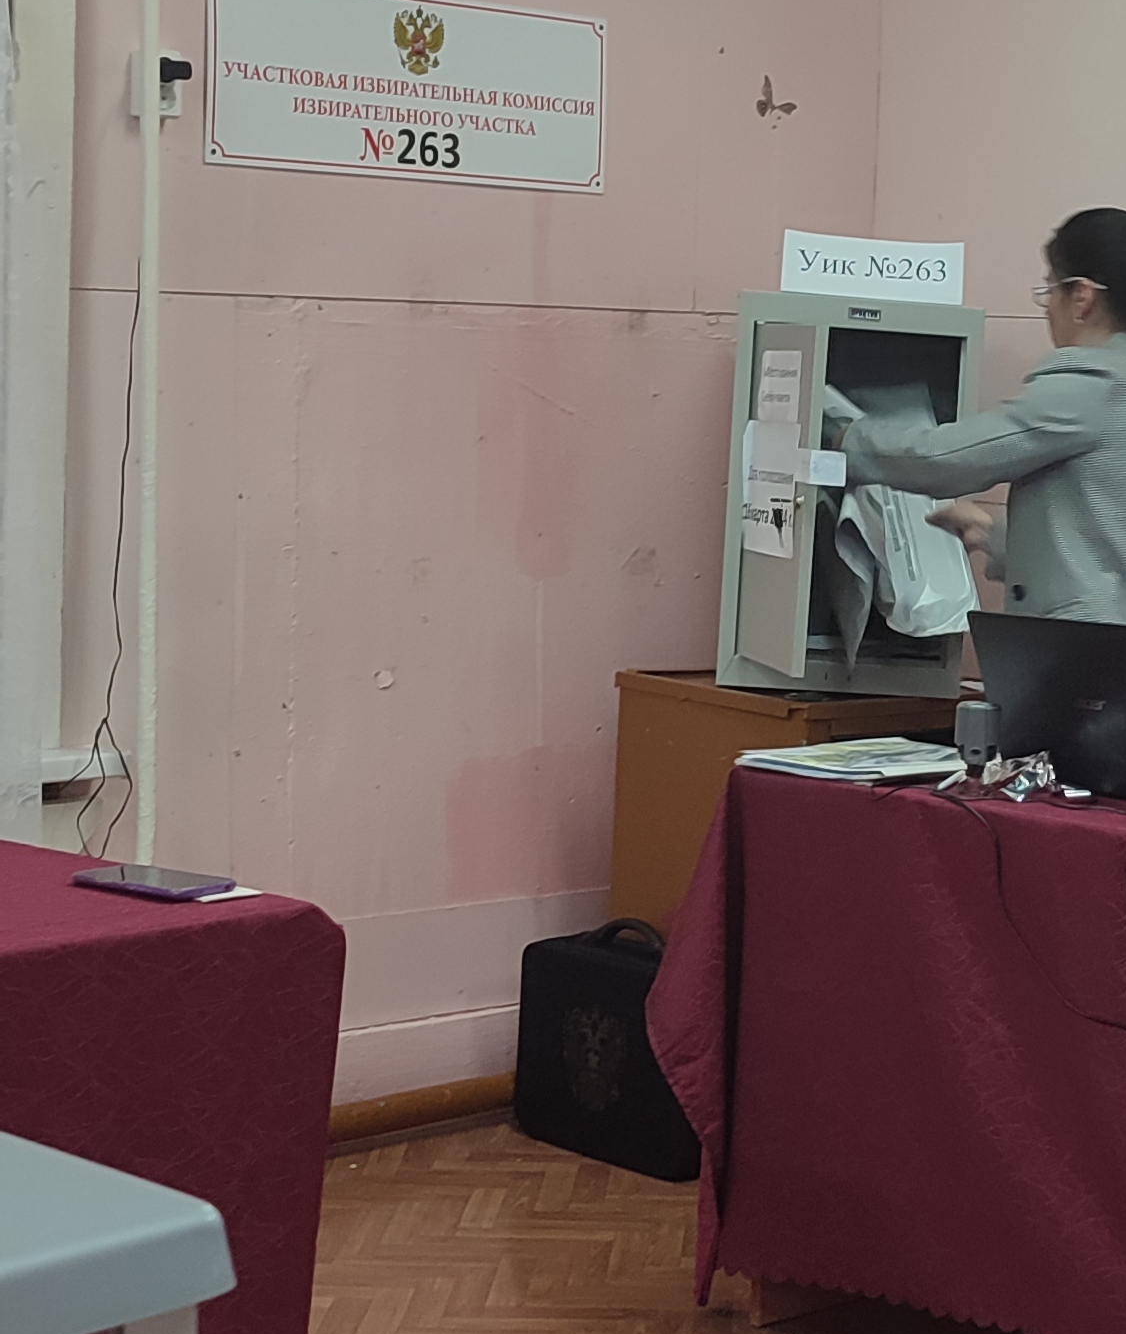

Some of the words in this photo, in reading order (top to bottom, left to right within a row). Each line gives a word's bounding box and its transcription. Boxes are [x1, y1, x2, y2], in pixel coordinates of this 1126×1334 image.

[222, 60, 348, 91] УЧАСТКОВАЯ
[353, 76, 498, 107] ИЗБИРАТЕЛЬНАЯ
[501, 92, 595, 117] КОМИССИЯ
[292, 96, 453, 128] ИЗБИРАТЕЛЬНОГО
[457, 113, 537, 136] УЧАСТКА
[359, 127, 460, 168] №263
[798, 248, 857, 276] Уик
[864, 255, 947, 282] №263
